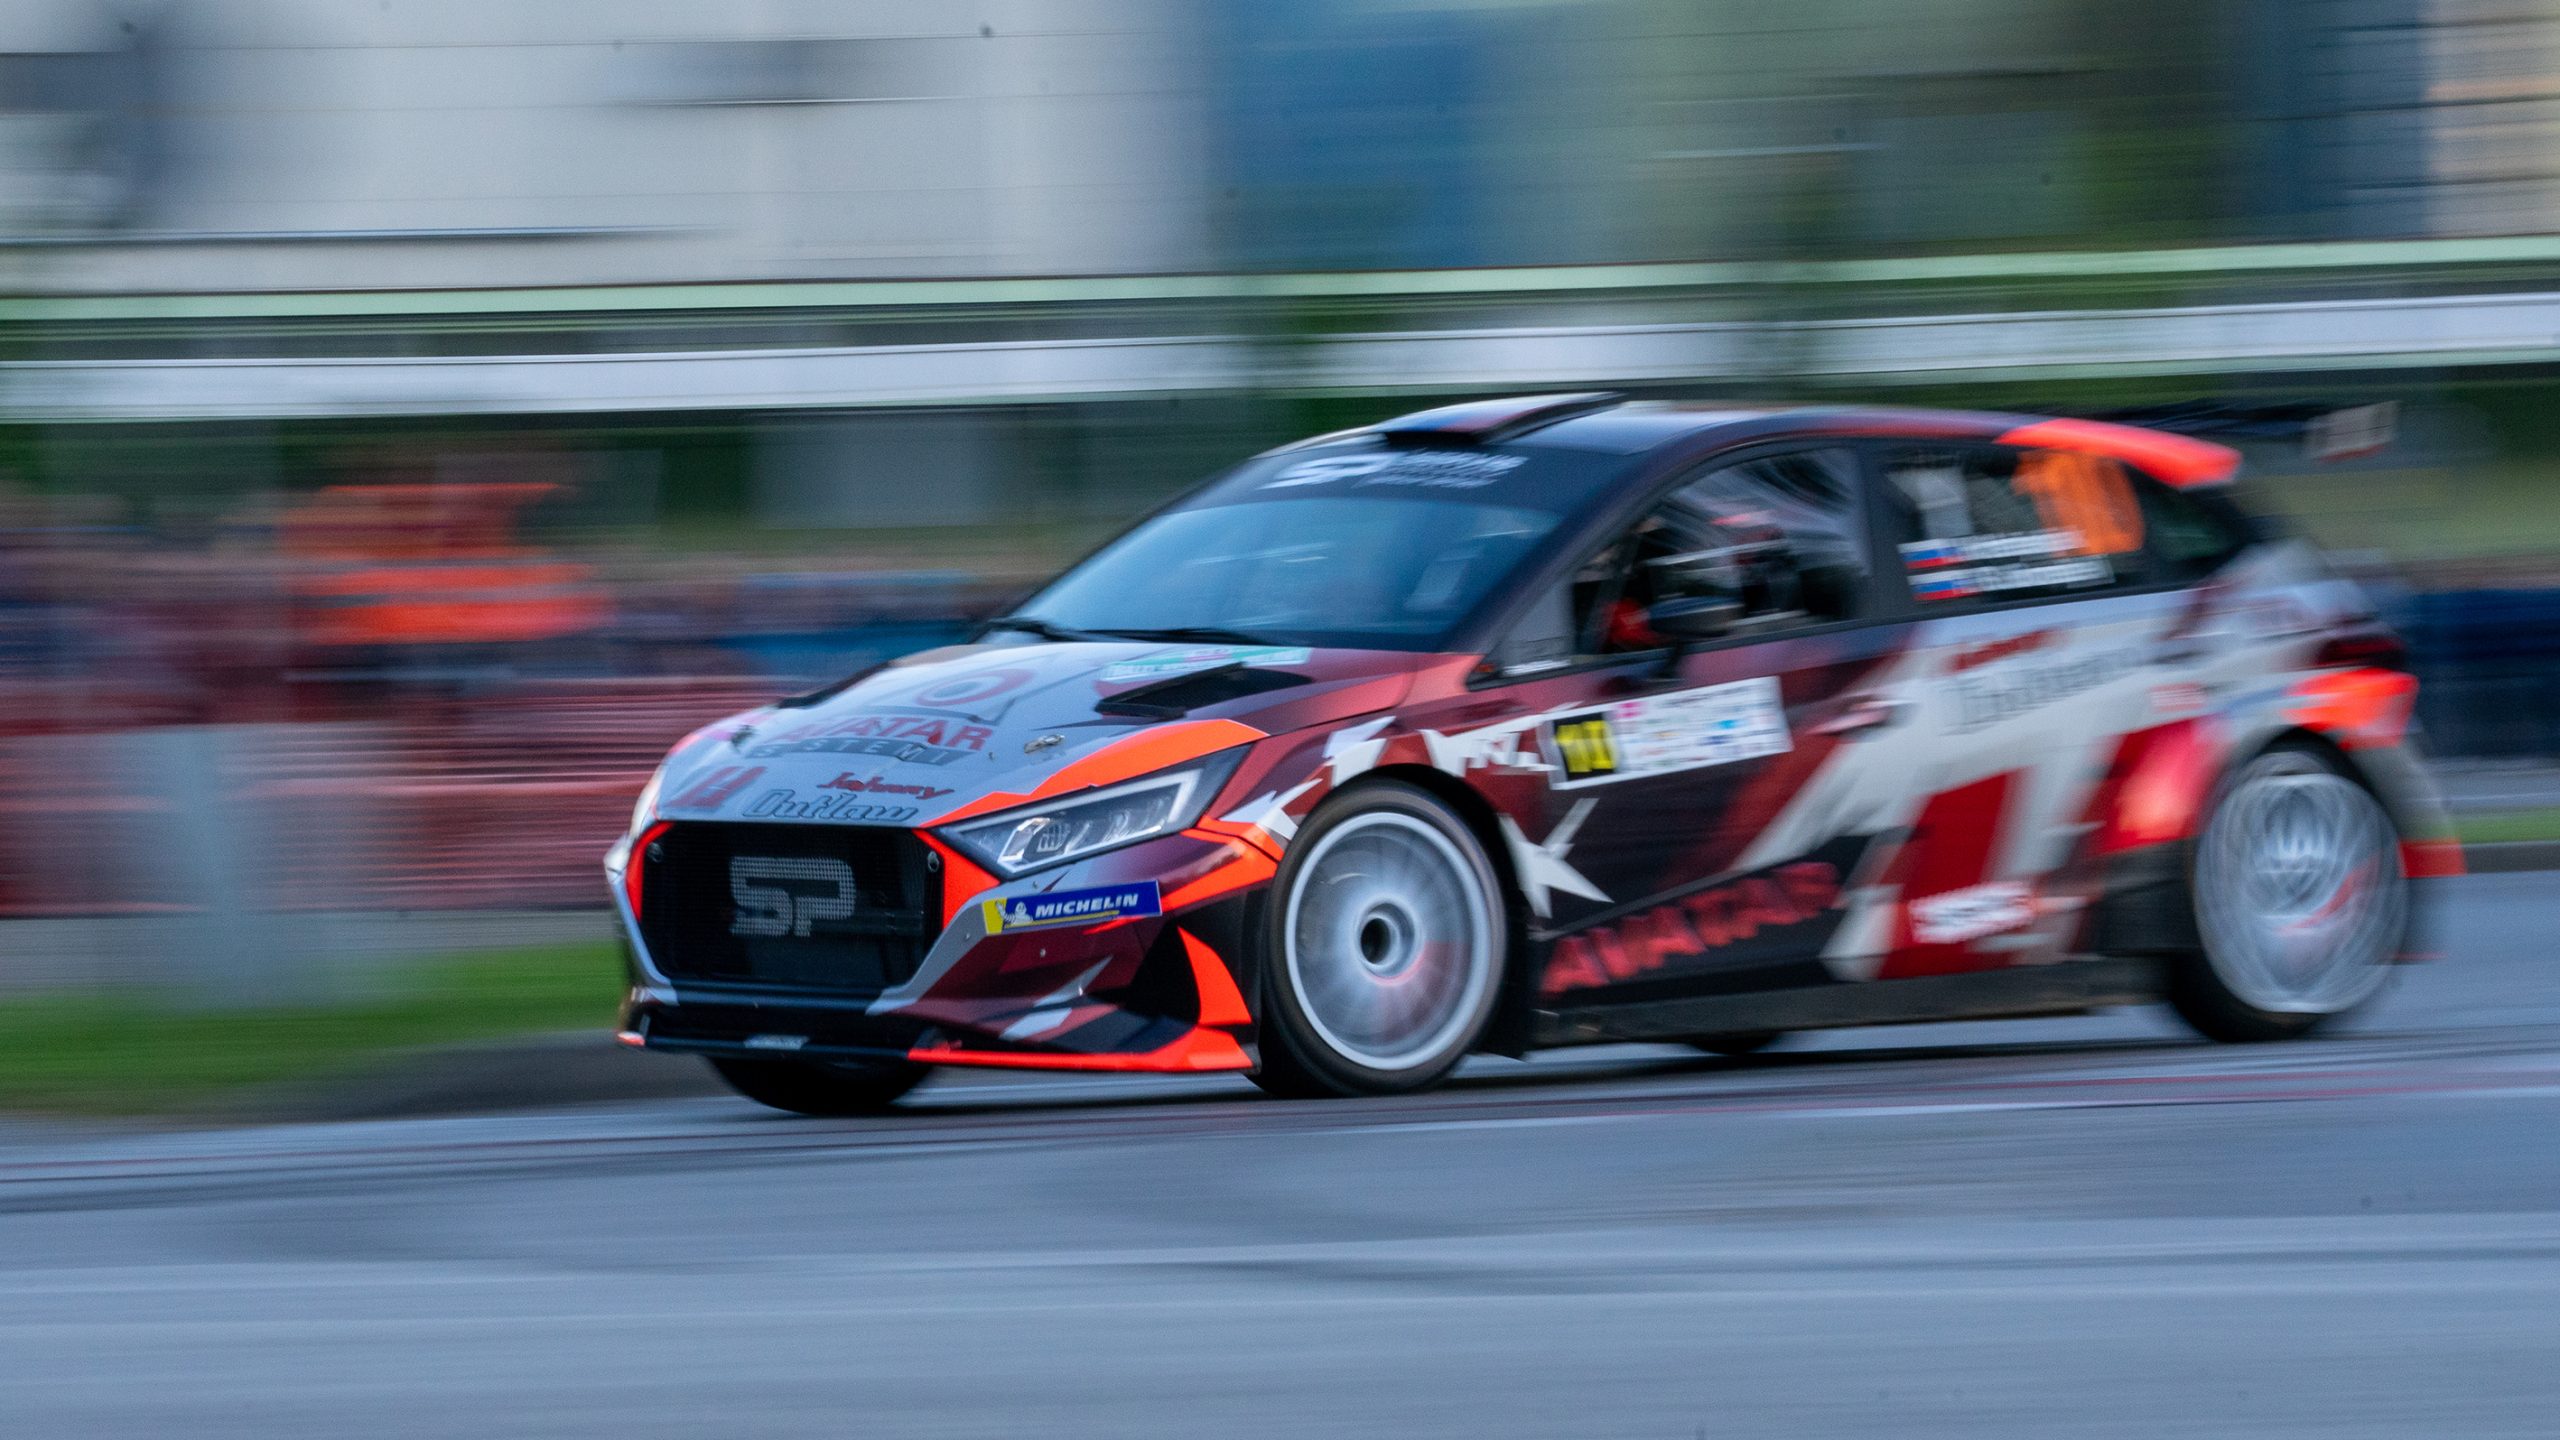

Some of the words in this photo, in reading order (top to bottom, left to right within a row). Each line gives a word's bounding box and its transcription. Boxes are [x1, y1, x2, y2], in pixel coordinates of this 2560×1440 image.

[816, 771, 955, 799] Johnny
[743, 788, 919, 822] Outlaw
[729, 855, 856, 937] SP
[1034, 893, 1139, 919] MICHELIN
